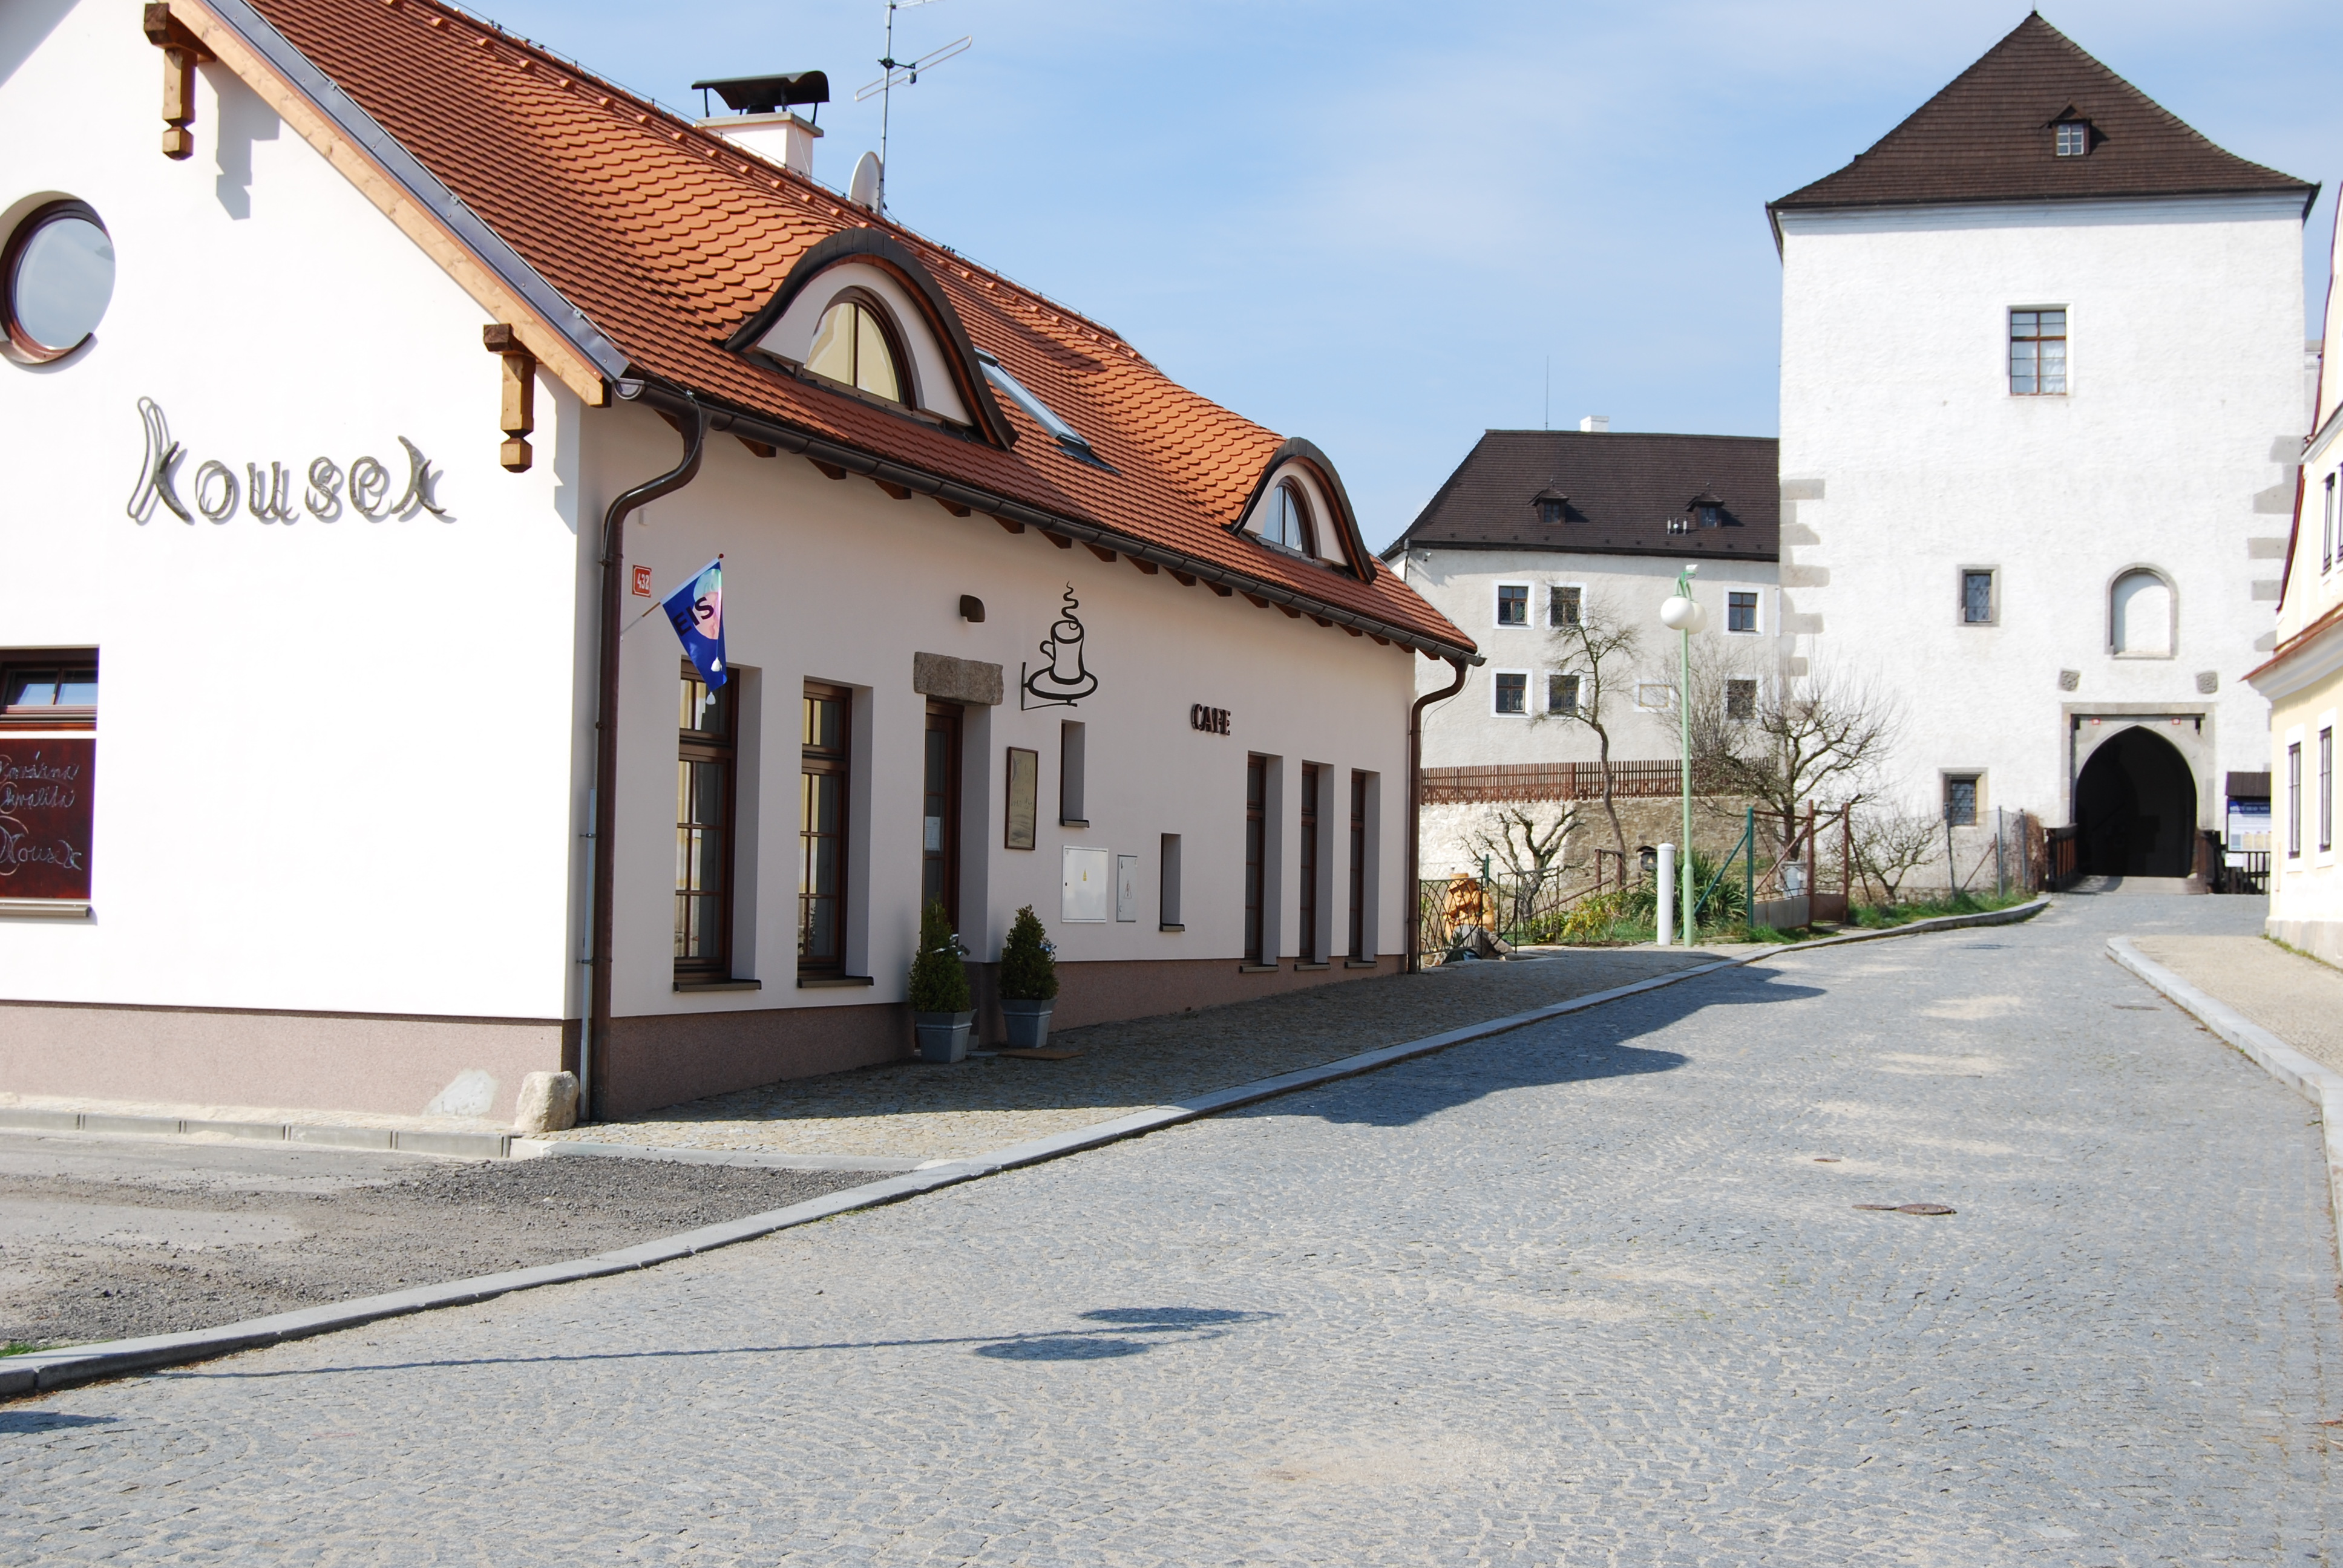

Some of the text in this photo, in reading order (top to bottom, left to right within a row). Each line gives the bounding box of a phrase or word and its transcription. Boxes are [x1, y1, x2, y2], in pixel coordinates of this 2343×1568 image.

[637, 573, 649, 590] 432
[672, 596, 714, 637] EIS
[1191, 703, 1231, 736] CAFE
